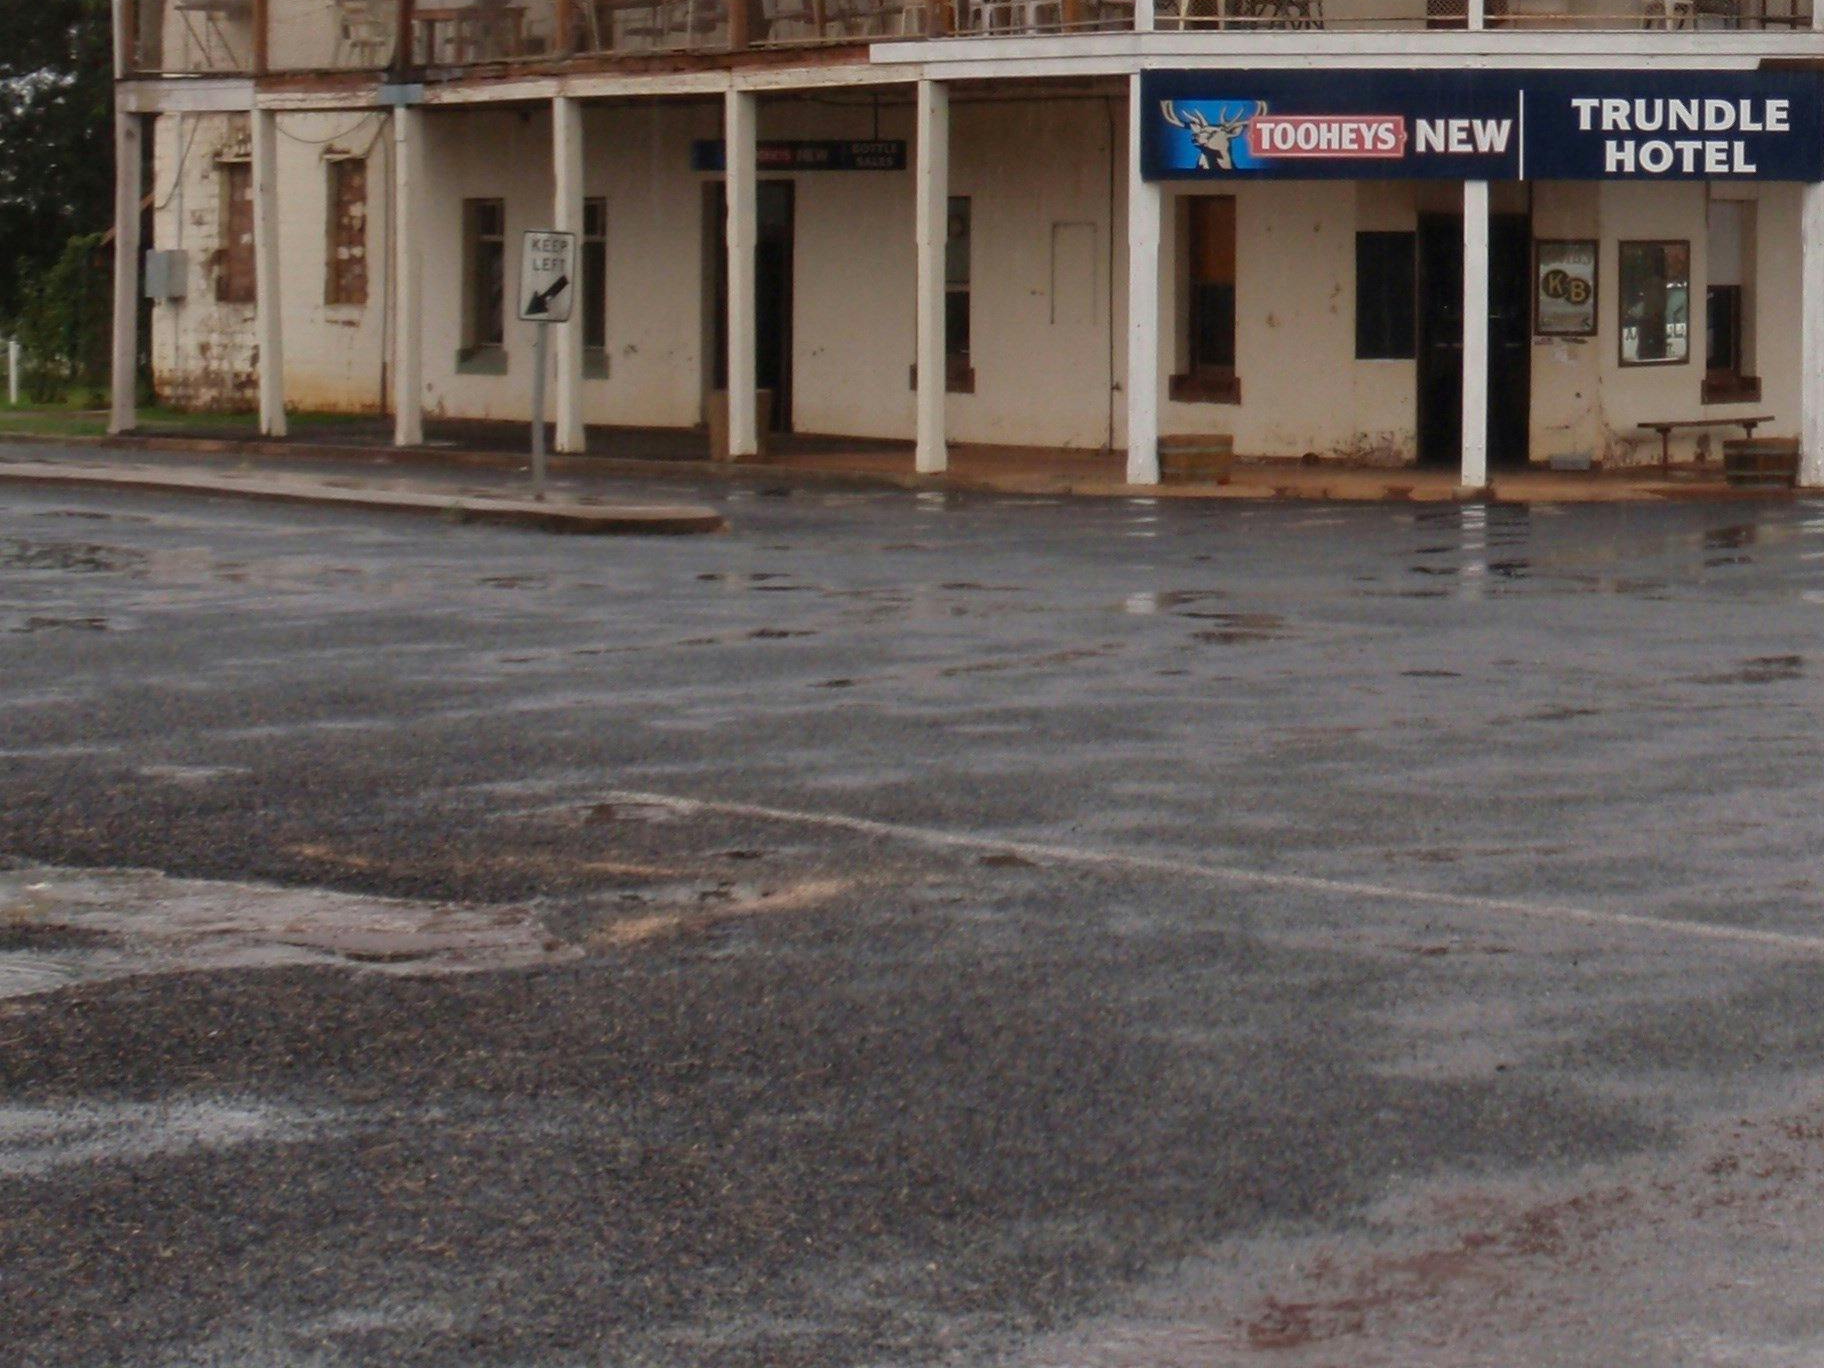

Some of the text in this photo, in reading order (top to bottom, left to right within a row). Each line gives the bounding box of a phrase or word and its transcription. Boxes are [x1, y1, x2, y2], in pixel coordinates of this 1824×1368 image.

[1571, 98, 1790, 131] TRUNDLE
[1256, 118, 1513, 153] TOOHEYS NEW
[1604, 140, 1757, 173] HOTEL
[531, 238, 568, 252] KEEP
[533, 257, 566, 271] LEFT
